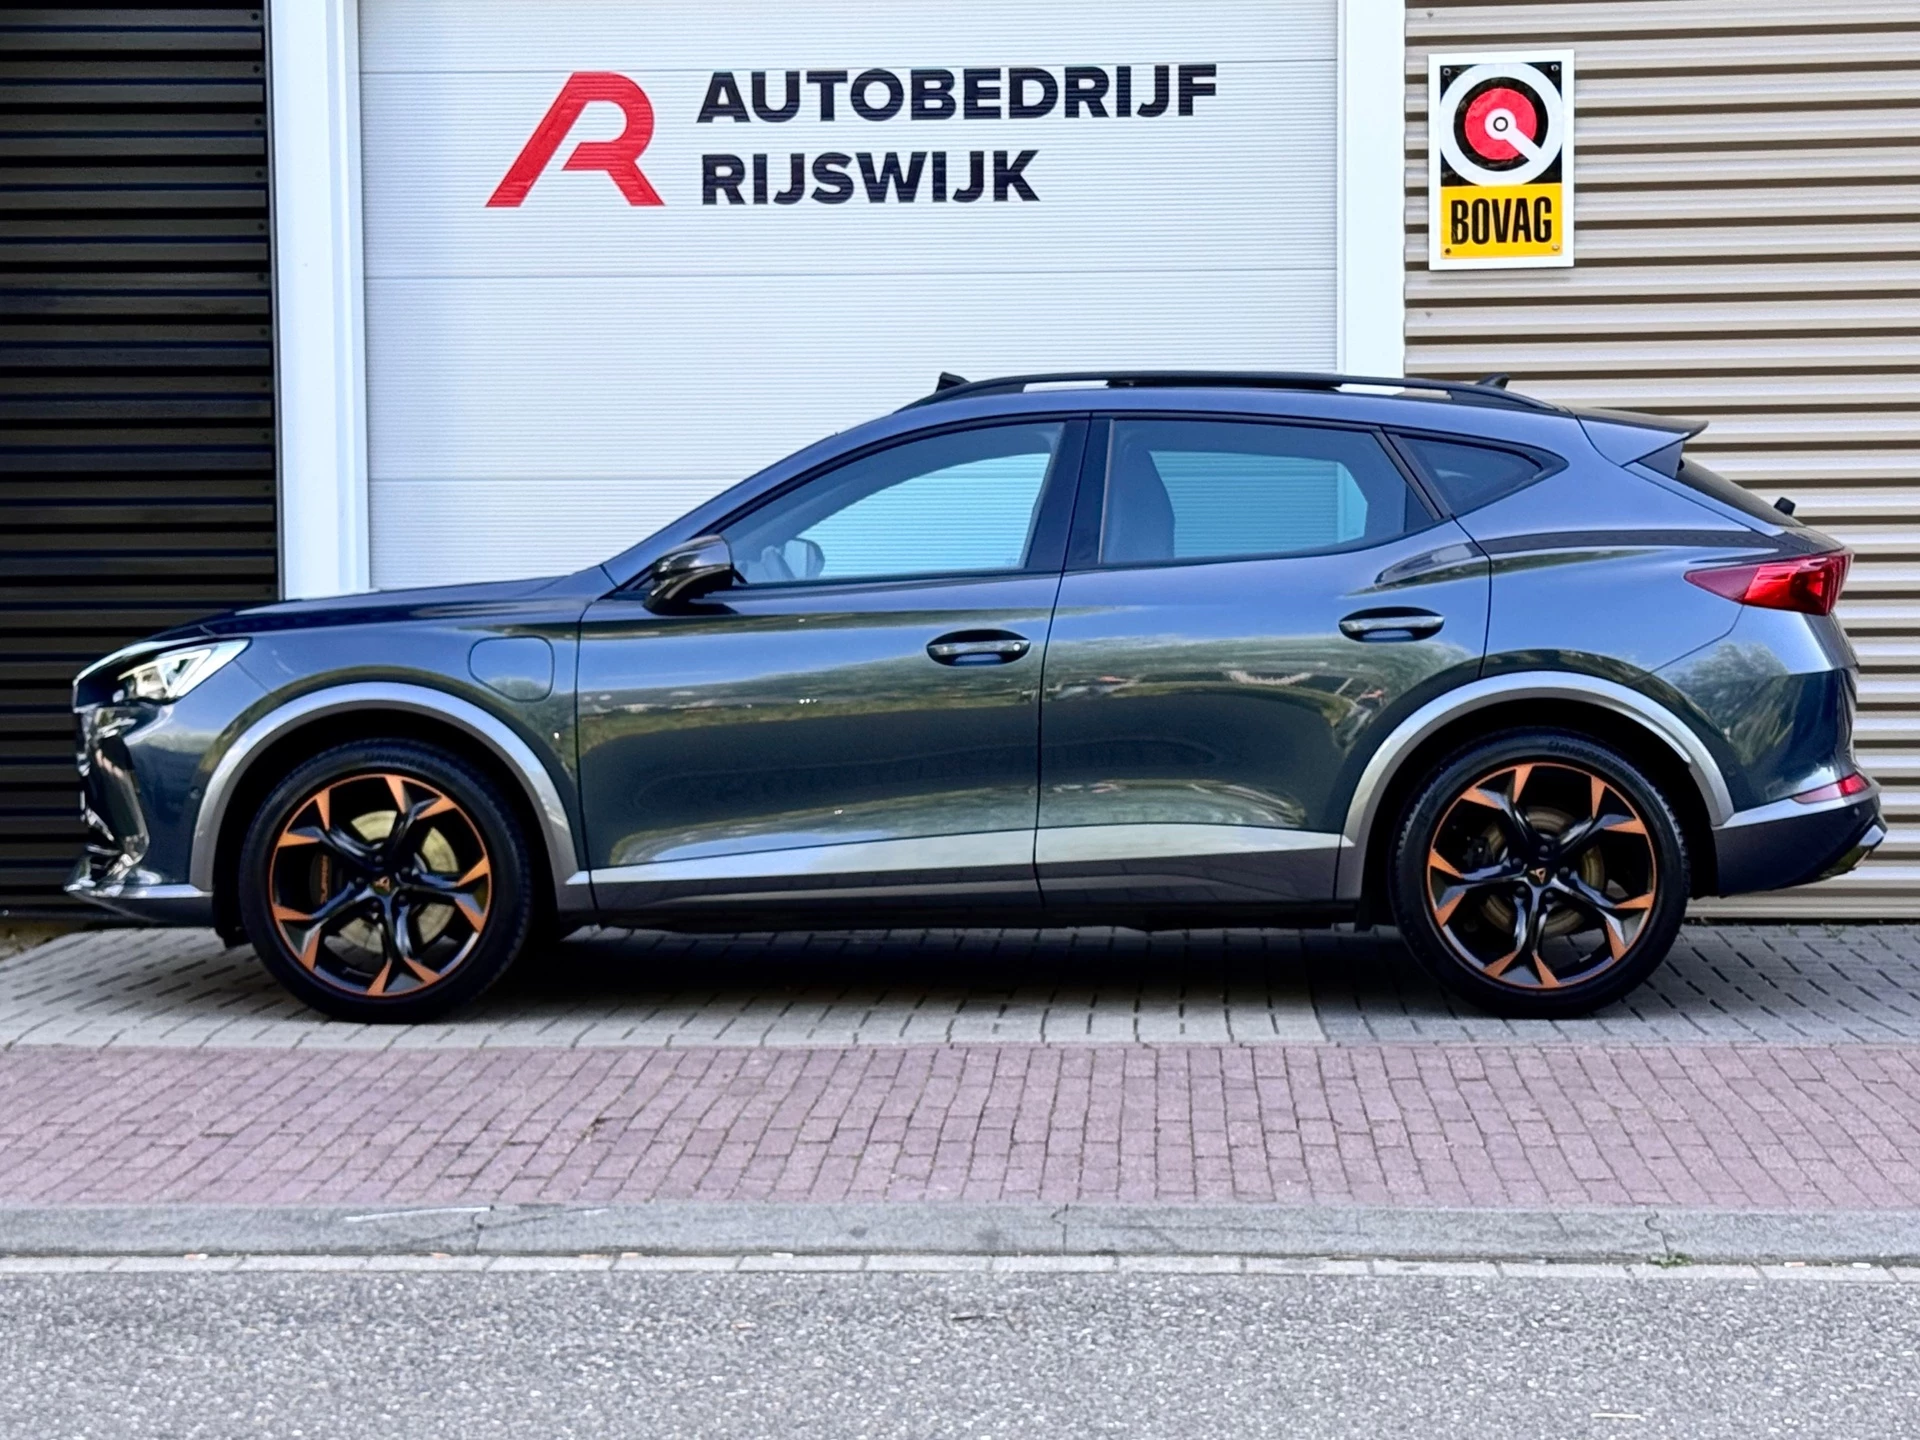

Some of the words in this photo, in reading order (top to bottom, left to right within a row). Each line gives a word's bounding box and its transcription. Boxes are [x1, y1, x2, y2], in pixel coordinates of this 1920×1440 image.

[696, 63, 1218, 124] AUTOBEDRIJF
[701, 149, 1041, 206] RIJSWIJK
[1450, 196, 1552, 245] BOVAG
